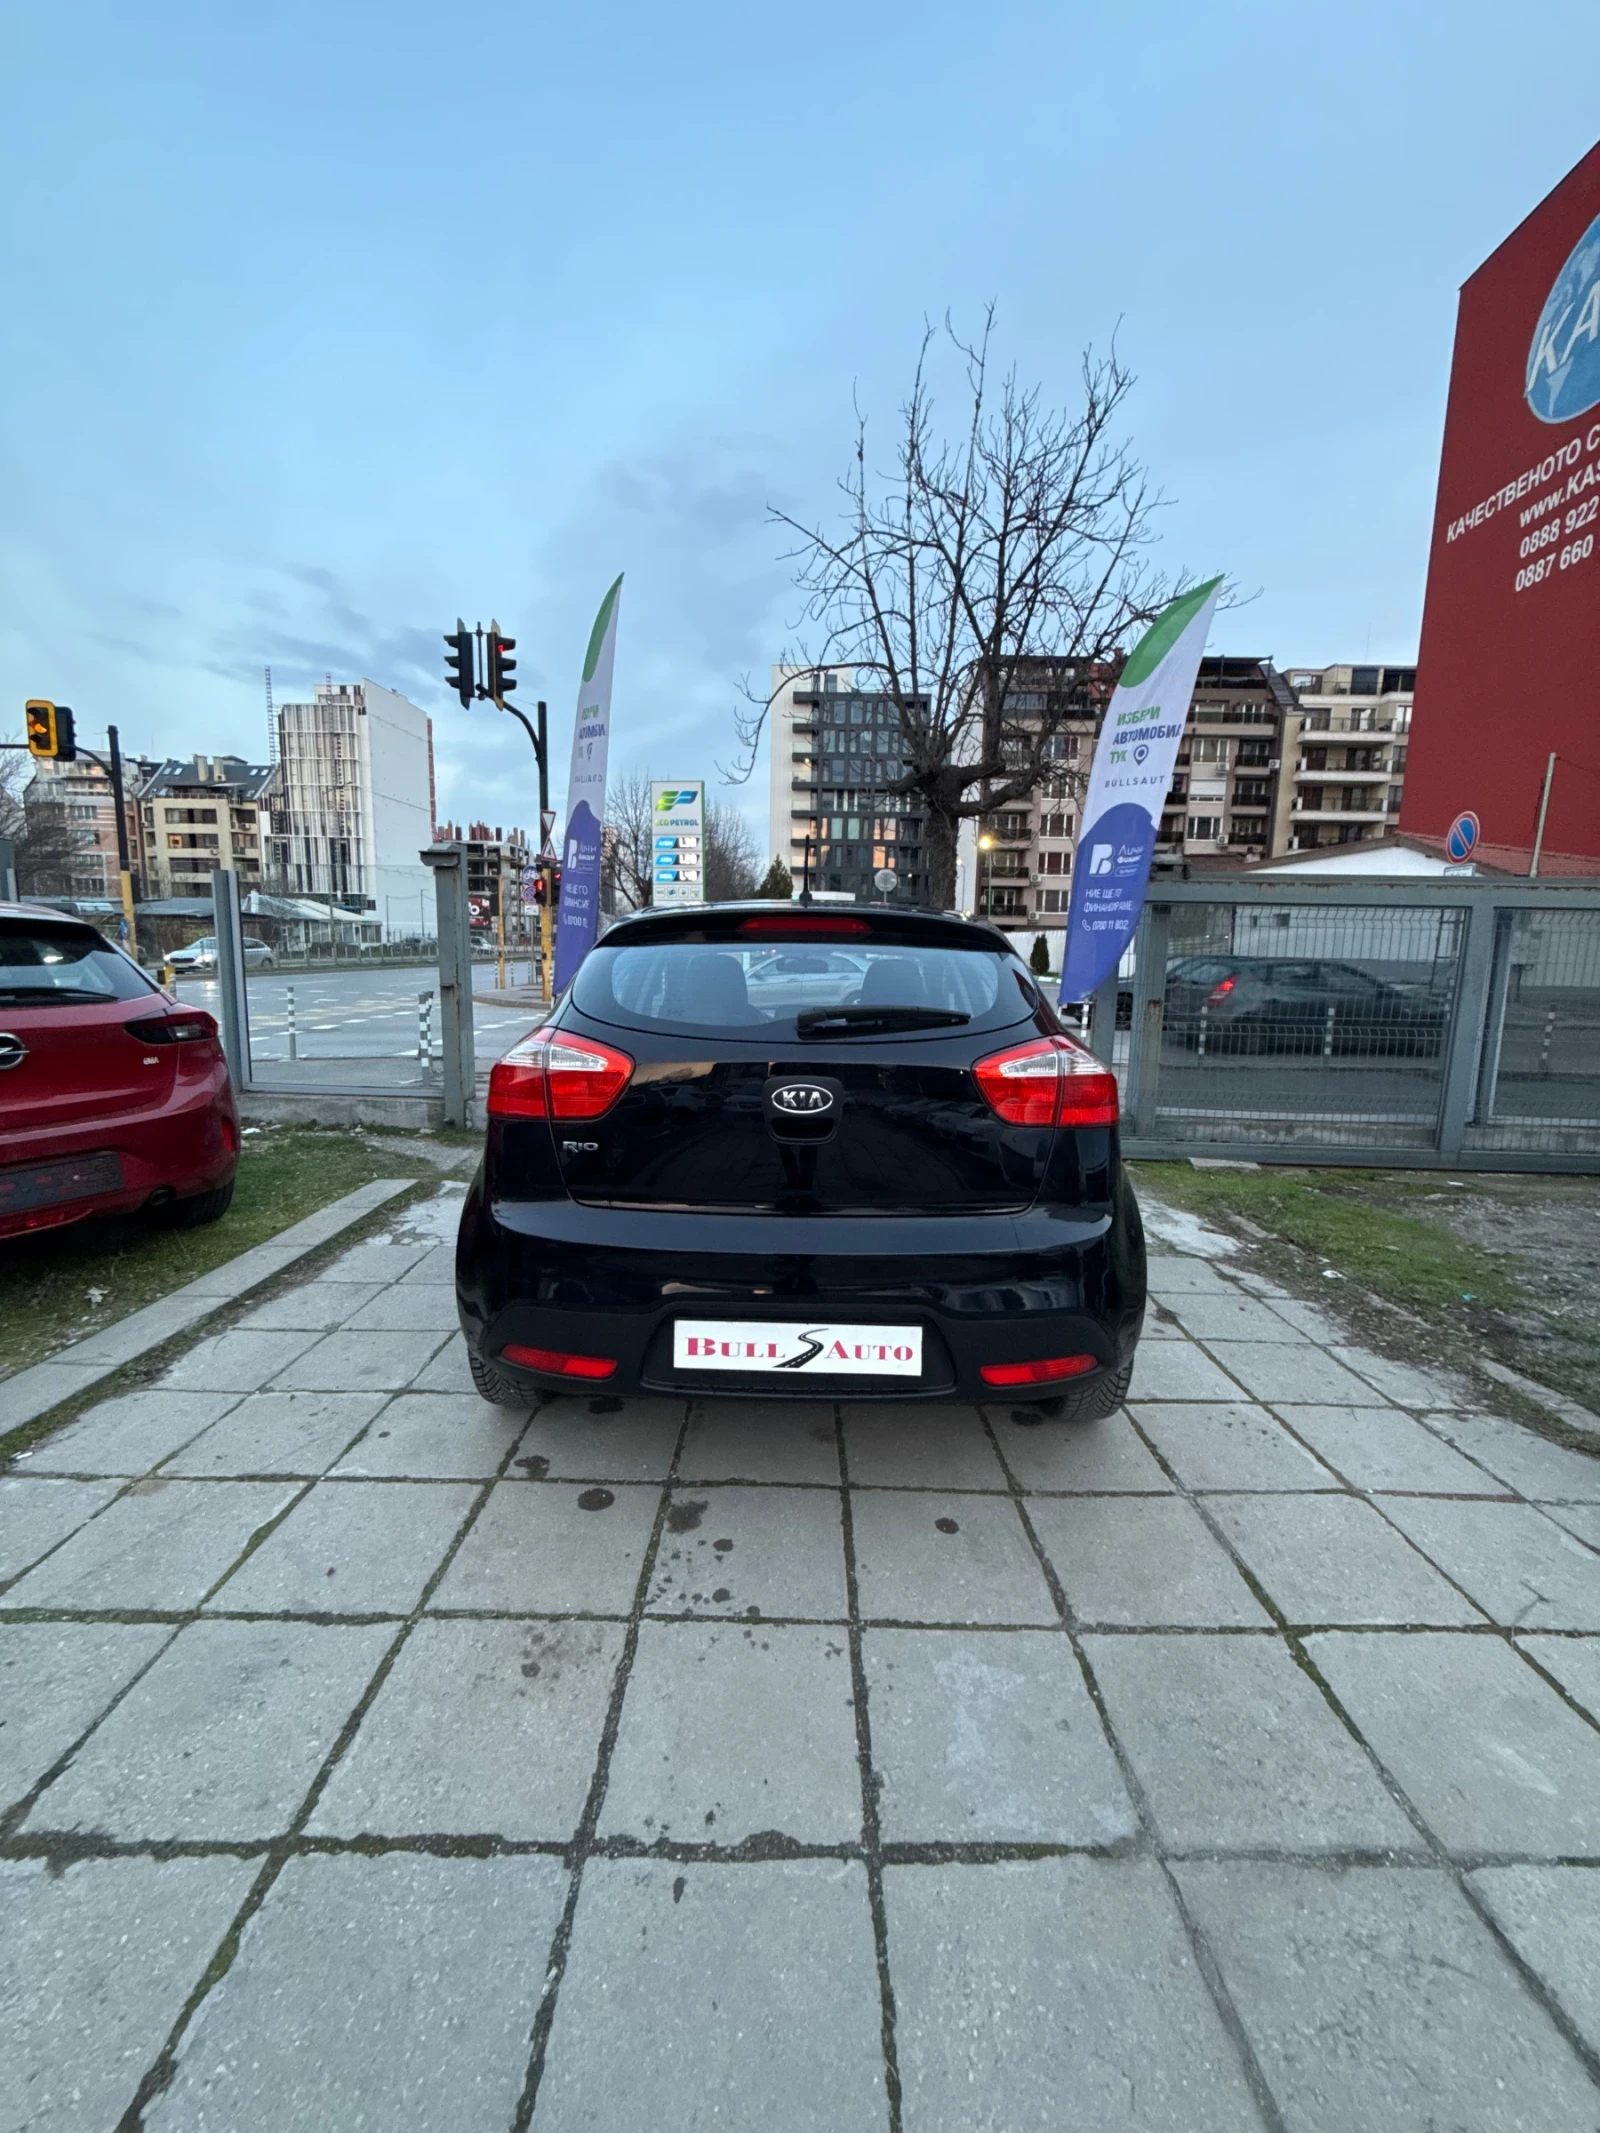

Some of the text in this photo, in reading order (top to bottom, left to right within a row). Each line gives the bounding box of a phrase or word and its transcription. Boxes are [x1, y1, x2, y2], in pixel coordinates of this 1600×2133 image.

[1446, 437, 1581, 544] КАЧЕСТВЕНОТО
[1520, 495, 1599, 559] 0888 922
[1515, 534, 1594, 592] 0887 660
[1110, 750, 1128, 764] ТУК
[670, 818, 699, 827] PETROL
[782, 1090, 824, 1107] KIA
[562, 1141, 599, 1152] RIO
